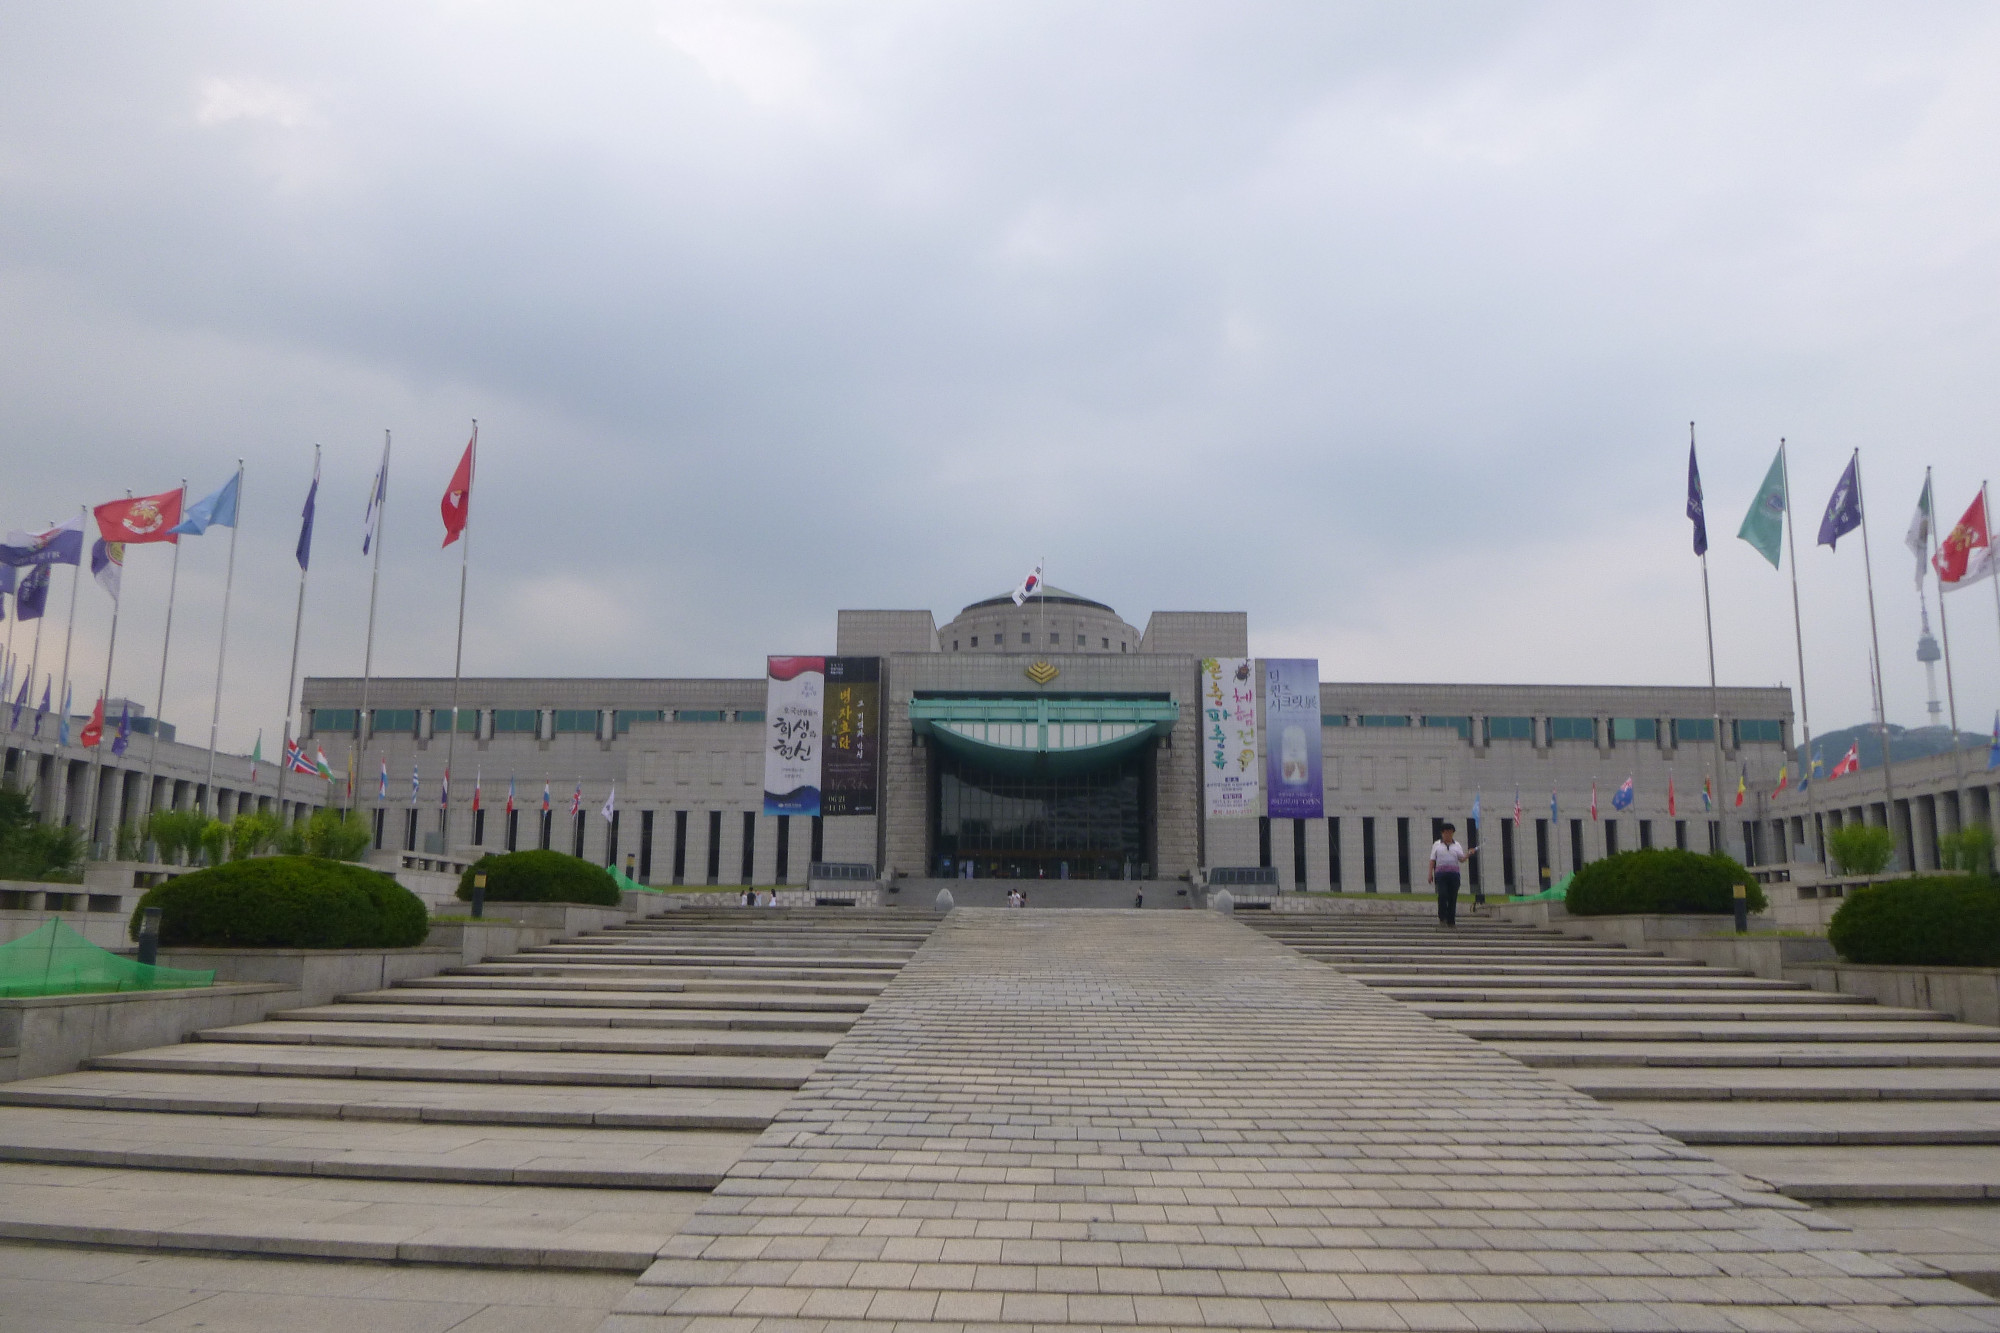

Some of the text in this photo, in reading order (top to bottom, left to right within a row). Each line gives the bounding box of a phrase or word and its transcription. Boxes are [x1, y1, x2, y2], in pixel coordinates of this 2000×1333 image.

[838, 687, 852, 750] 병자호란
[1233, 687, 1254, 745] 체험전
[773, 739, 811, 761] 헌신
